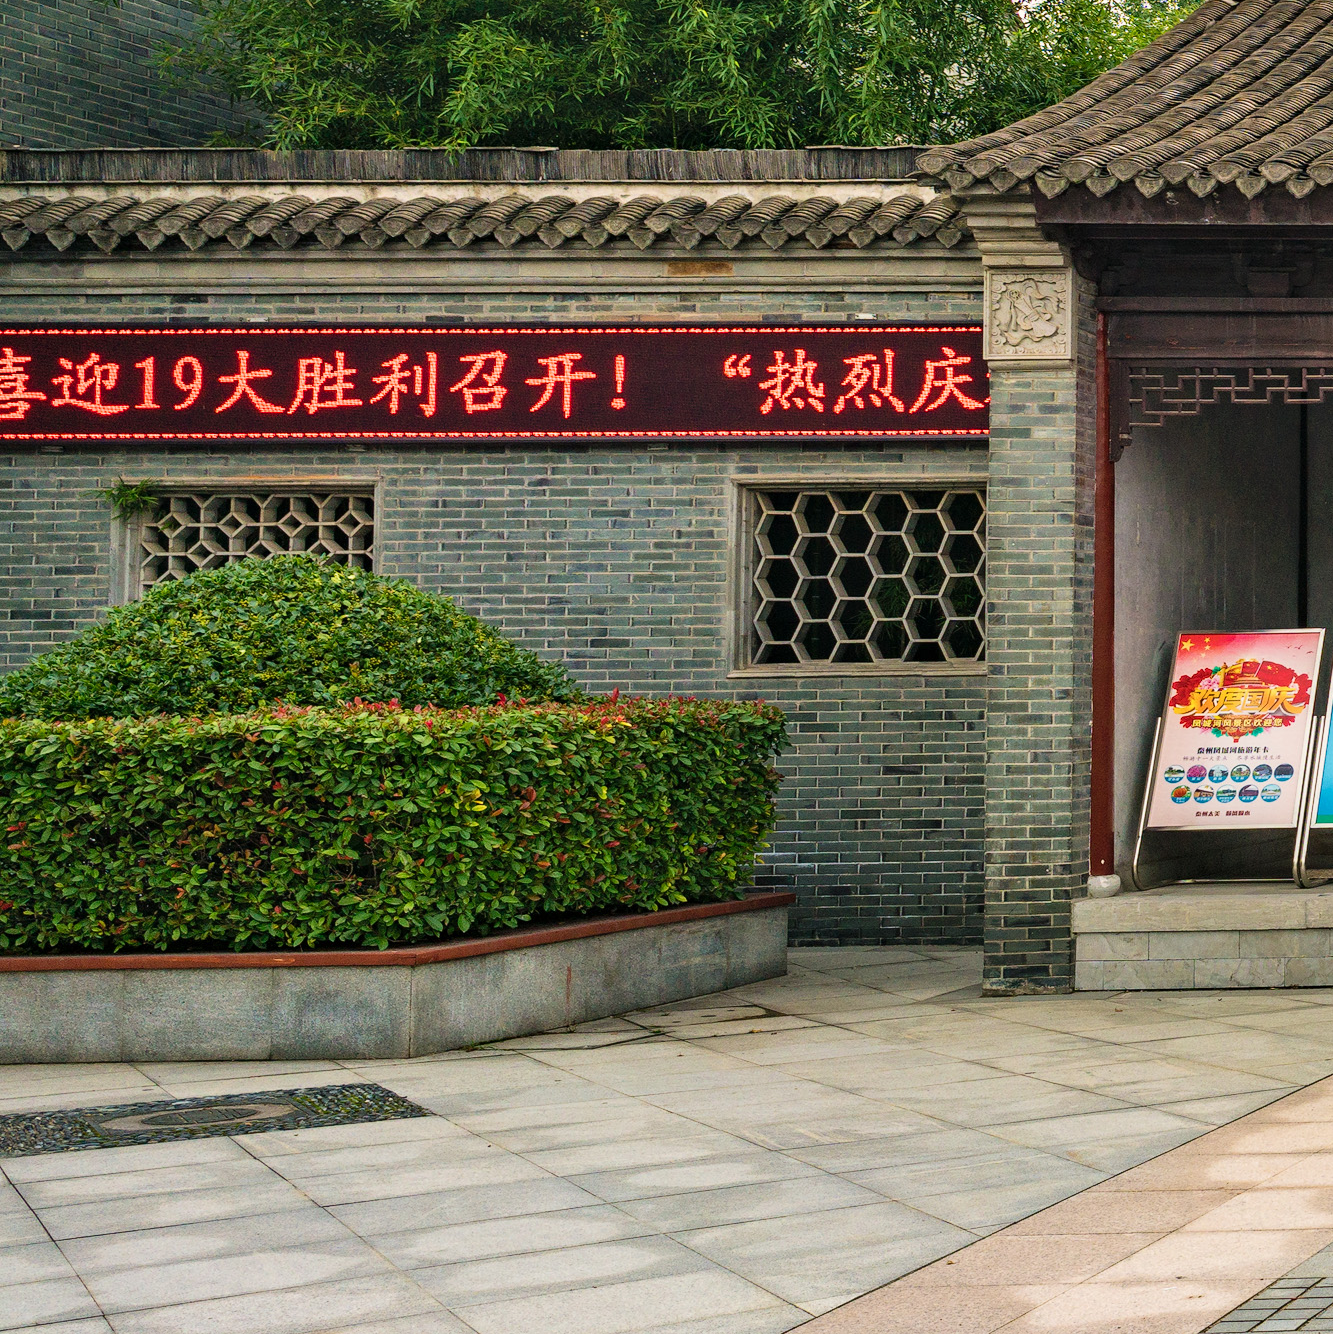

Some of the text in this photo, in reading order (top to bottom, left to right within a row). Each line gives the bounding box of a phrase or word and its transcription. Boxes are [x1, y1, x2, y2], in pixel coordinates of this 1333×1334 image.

[723, 346, 990, 414] “热烈庆
[1173, 686, 1306, 714] 欢度国庆
